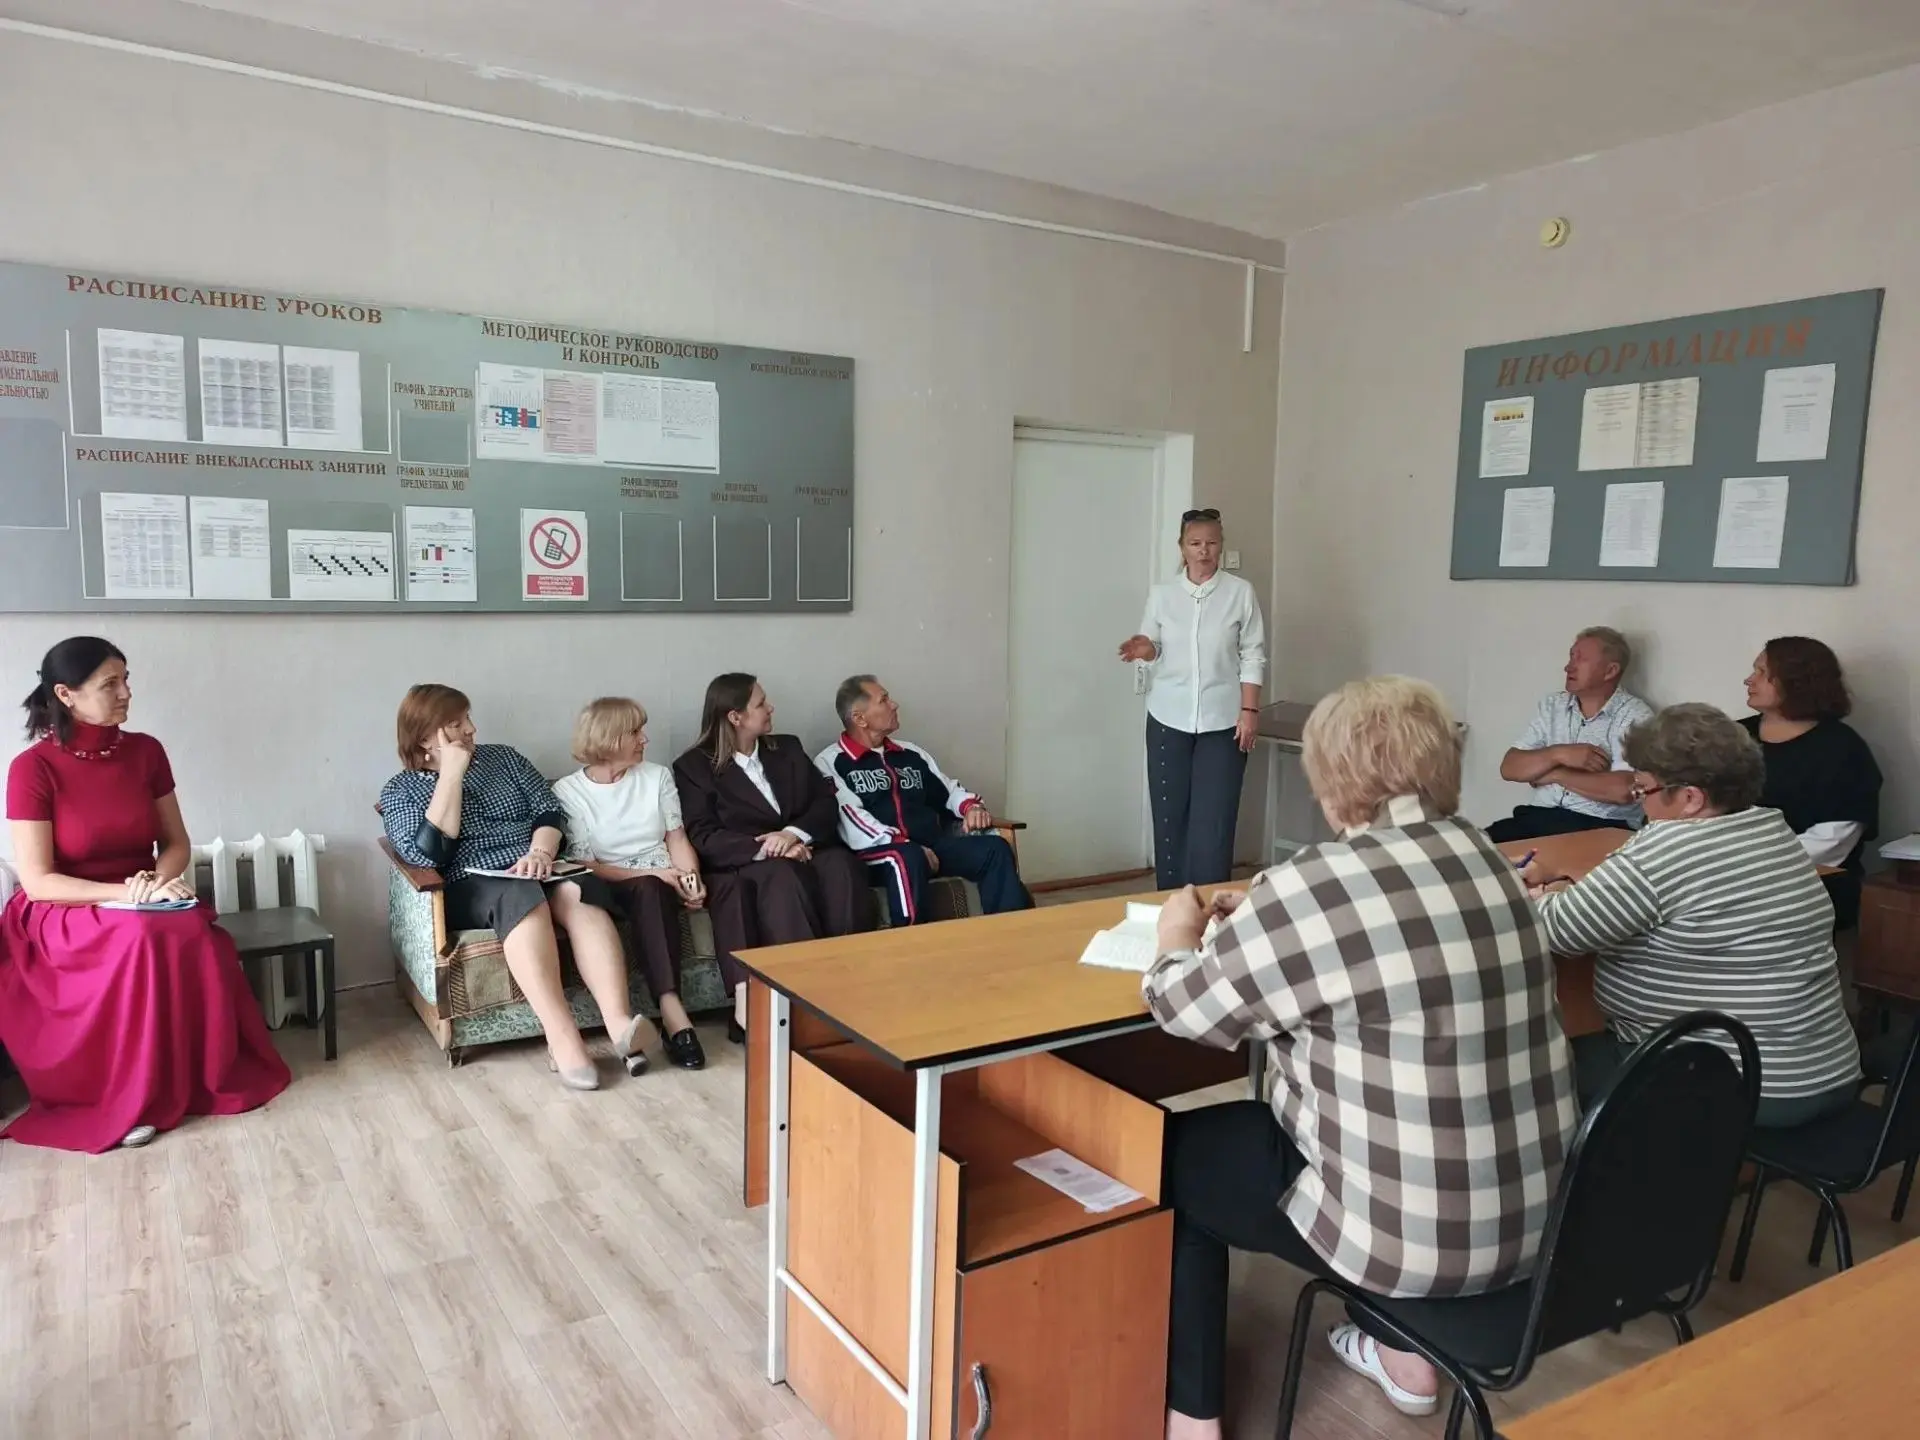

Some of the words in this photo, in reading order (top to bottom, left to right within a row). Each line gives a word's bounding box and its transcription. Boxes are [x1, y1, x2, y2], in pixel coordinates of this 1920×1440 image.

[66, 274, 266, 311] РАСПИСАНИЕ
[276, 297, 382, 324] УРОКОВ
[481, 320, 610, 348] МЕТОДИЧЕСКОЕ
[615, 336, 719, 361] РУКОВОДСТВО
[1495, 318, 1813, 388] ИНФОРМАЦИЯ
[562, 347, 573, 361] И
[579, 349, 660, 370] КОНТРОЛЬ
[394, 382, 426, 395] ГРАФИК
[427, 385, 473, 399] ДЕЖУРСТВА
[414, 399, 455, 412] УЧИТЕЛЕЙ
[76, 448, 188, 465] РАСПИСАНИЕ
[196, 454, 314, 471] ВНЕКЛАССНЫХ
[319, 460, 386, 475] ЗАНЯТИЙ
[397, 466, 425, 476] ГРАФИК
